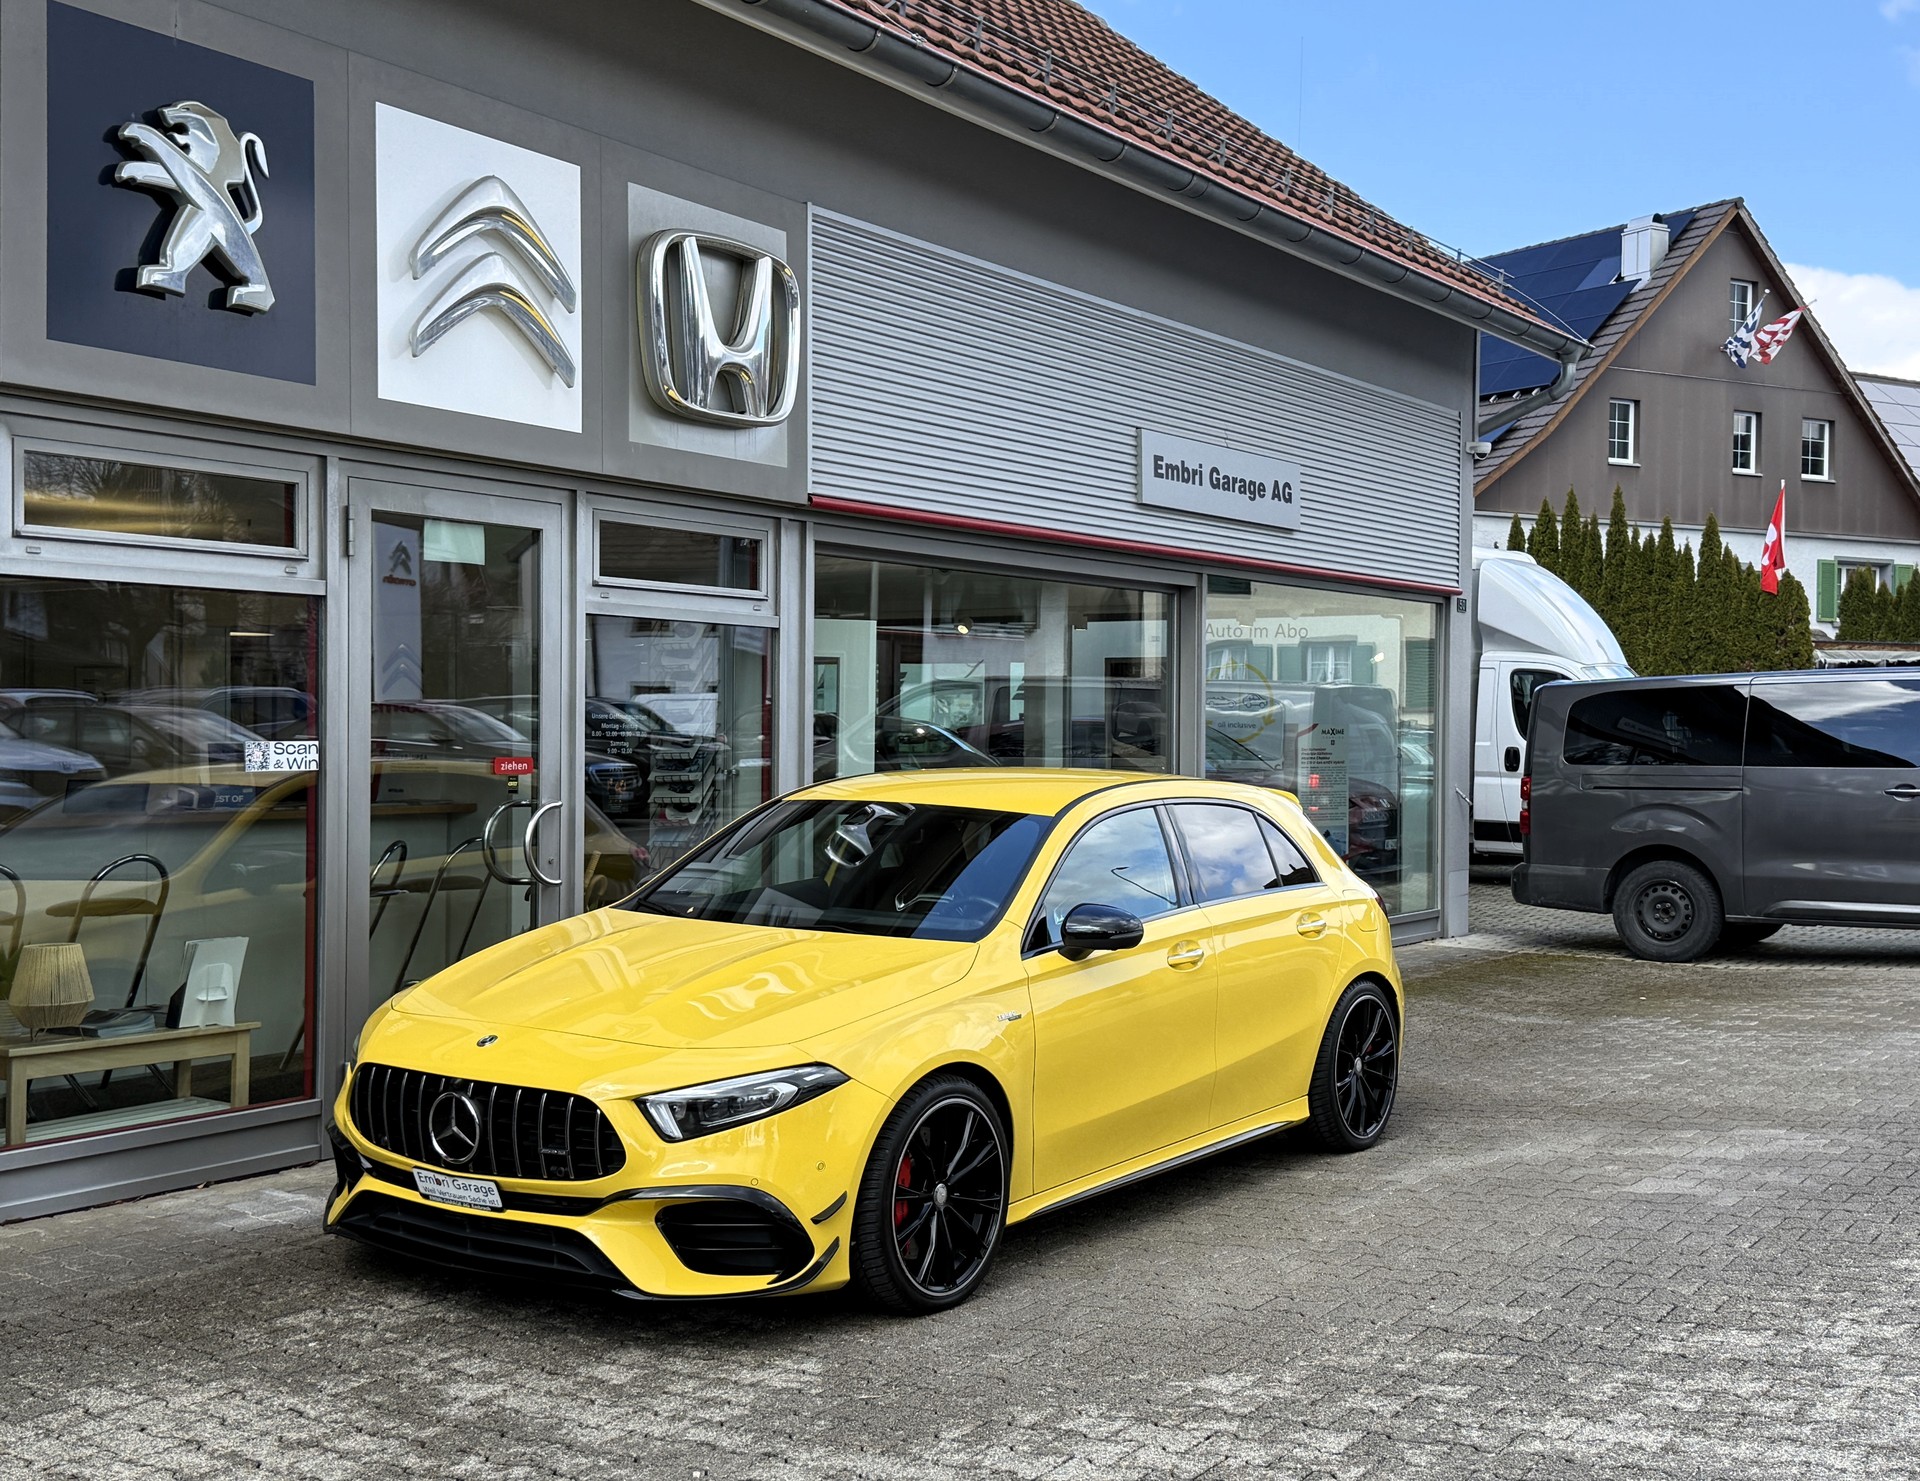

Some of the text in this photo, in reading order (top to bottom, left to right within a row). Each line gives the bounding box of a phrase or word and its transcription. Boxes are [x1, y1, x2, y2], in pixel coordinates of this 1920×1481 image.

[1153, 454, 1293, 504] Embri Garage AG
[1205, 624, 1243, 639] Auto
[1275, 624, 1309, 639] Abo
[601, 722, 620, 730] Montag
[1227, 721, 1257, 729] inclusive
[1321, 728, 1345, 736] MAXIME
[273, 742, 318, 755] Scan
[273, 756, 318, 769] & Win
[500, 761, 528, 771] ziehen
[215, 794, 244, 803] EST OF
[417, 1171, 496, 1197] Embri Garage
[437, 1188, 468, 1201] Vertrauen
